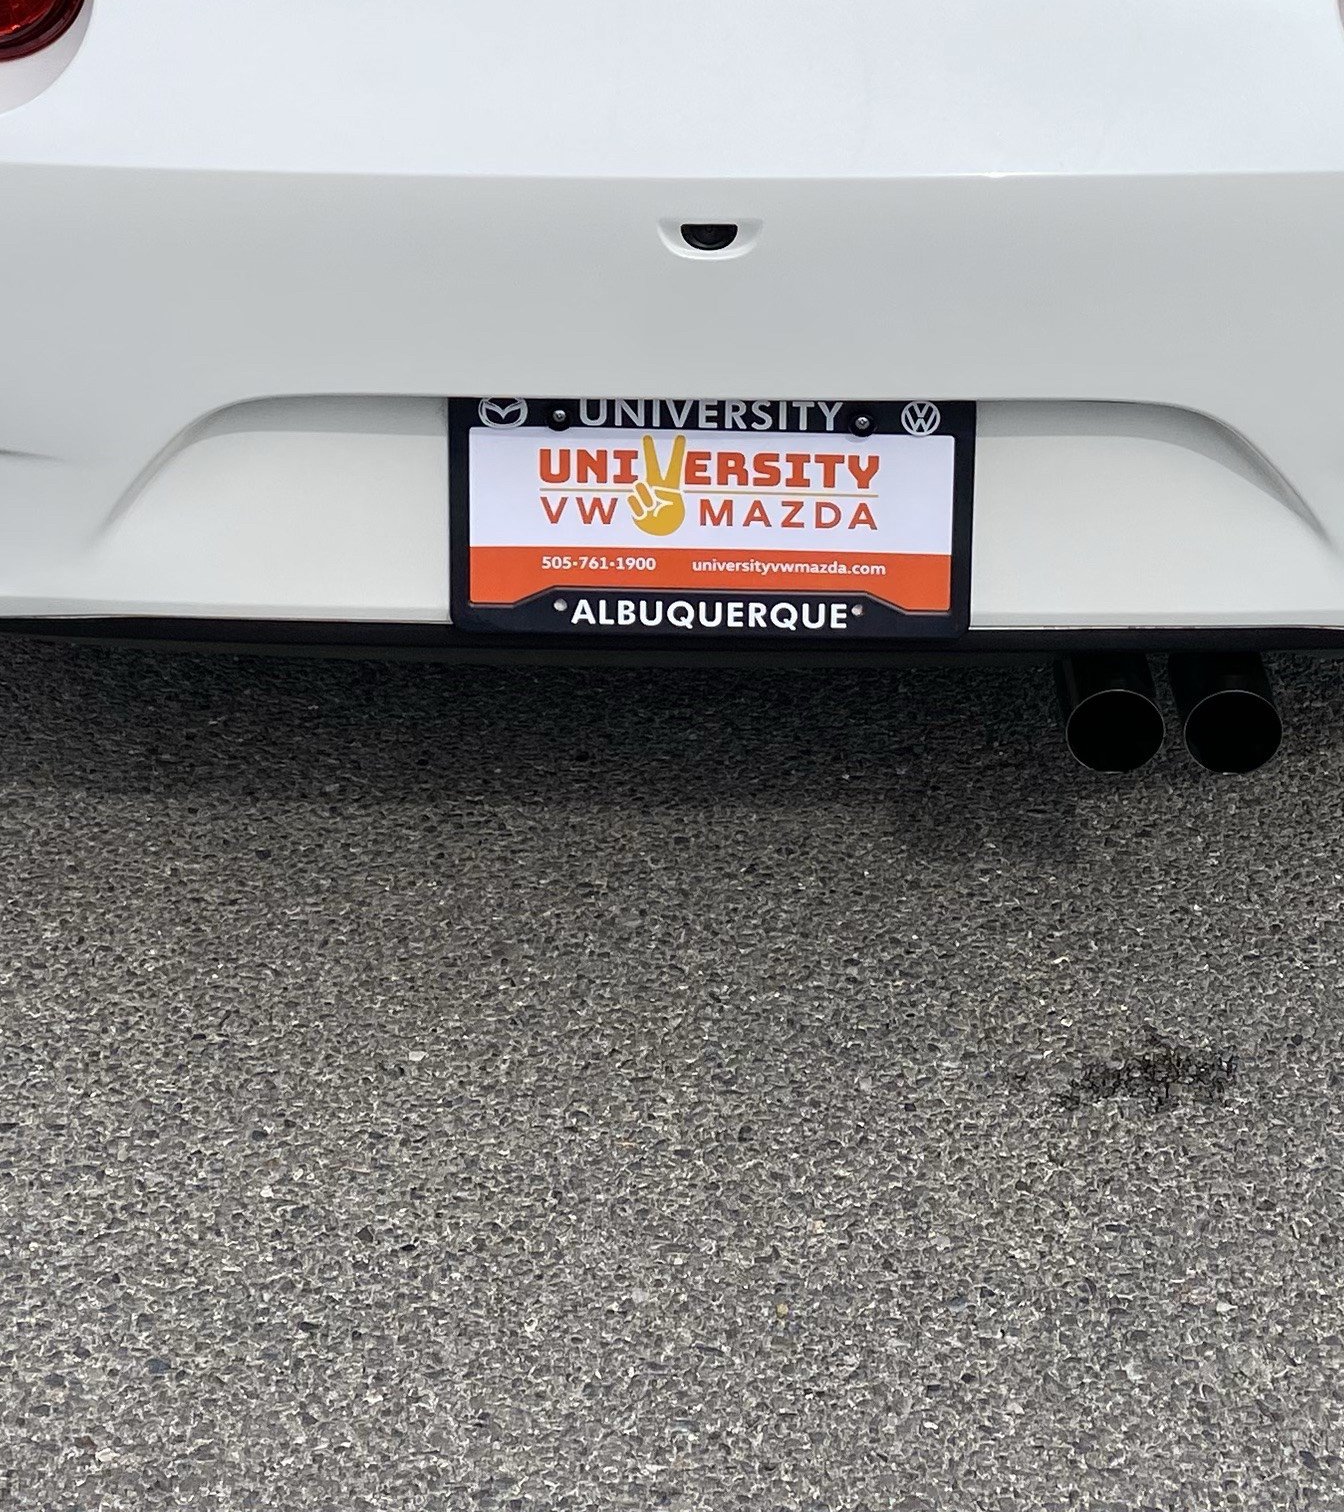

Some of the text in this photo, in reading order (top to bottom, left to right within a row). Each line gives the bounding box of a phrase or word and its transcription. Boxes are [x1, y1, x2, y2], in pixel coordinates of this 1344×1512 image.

[579, 398, 844, 432] UNIVERSITY
[538, 434, 881, 491] UNIVERSITY
[539, 495, 879, 531] VW MAZDA
[691, 557, 887, 577] universityvwmazda.com
[570, 597, 848, 631] ALBUQUERQUE
